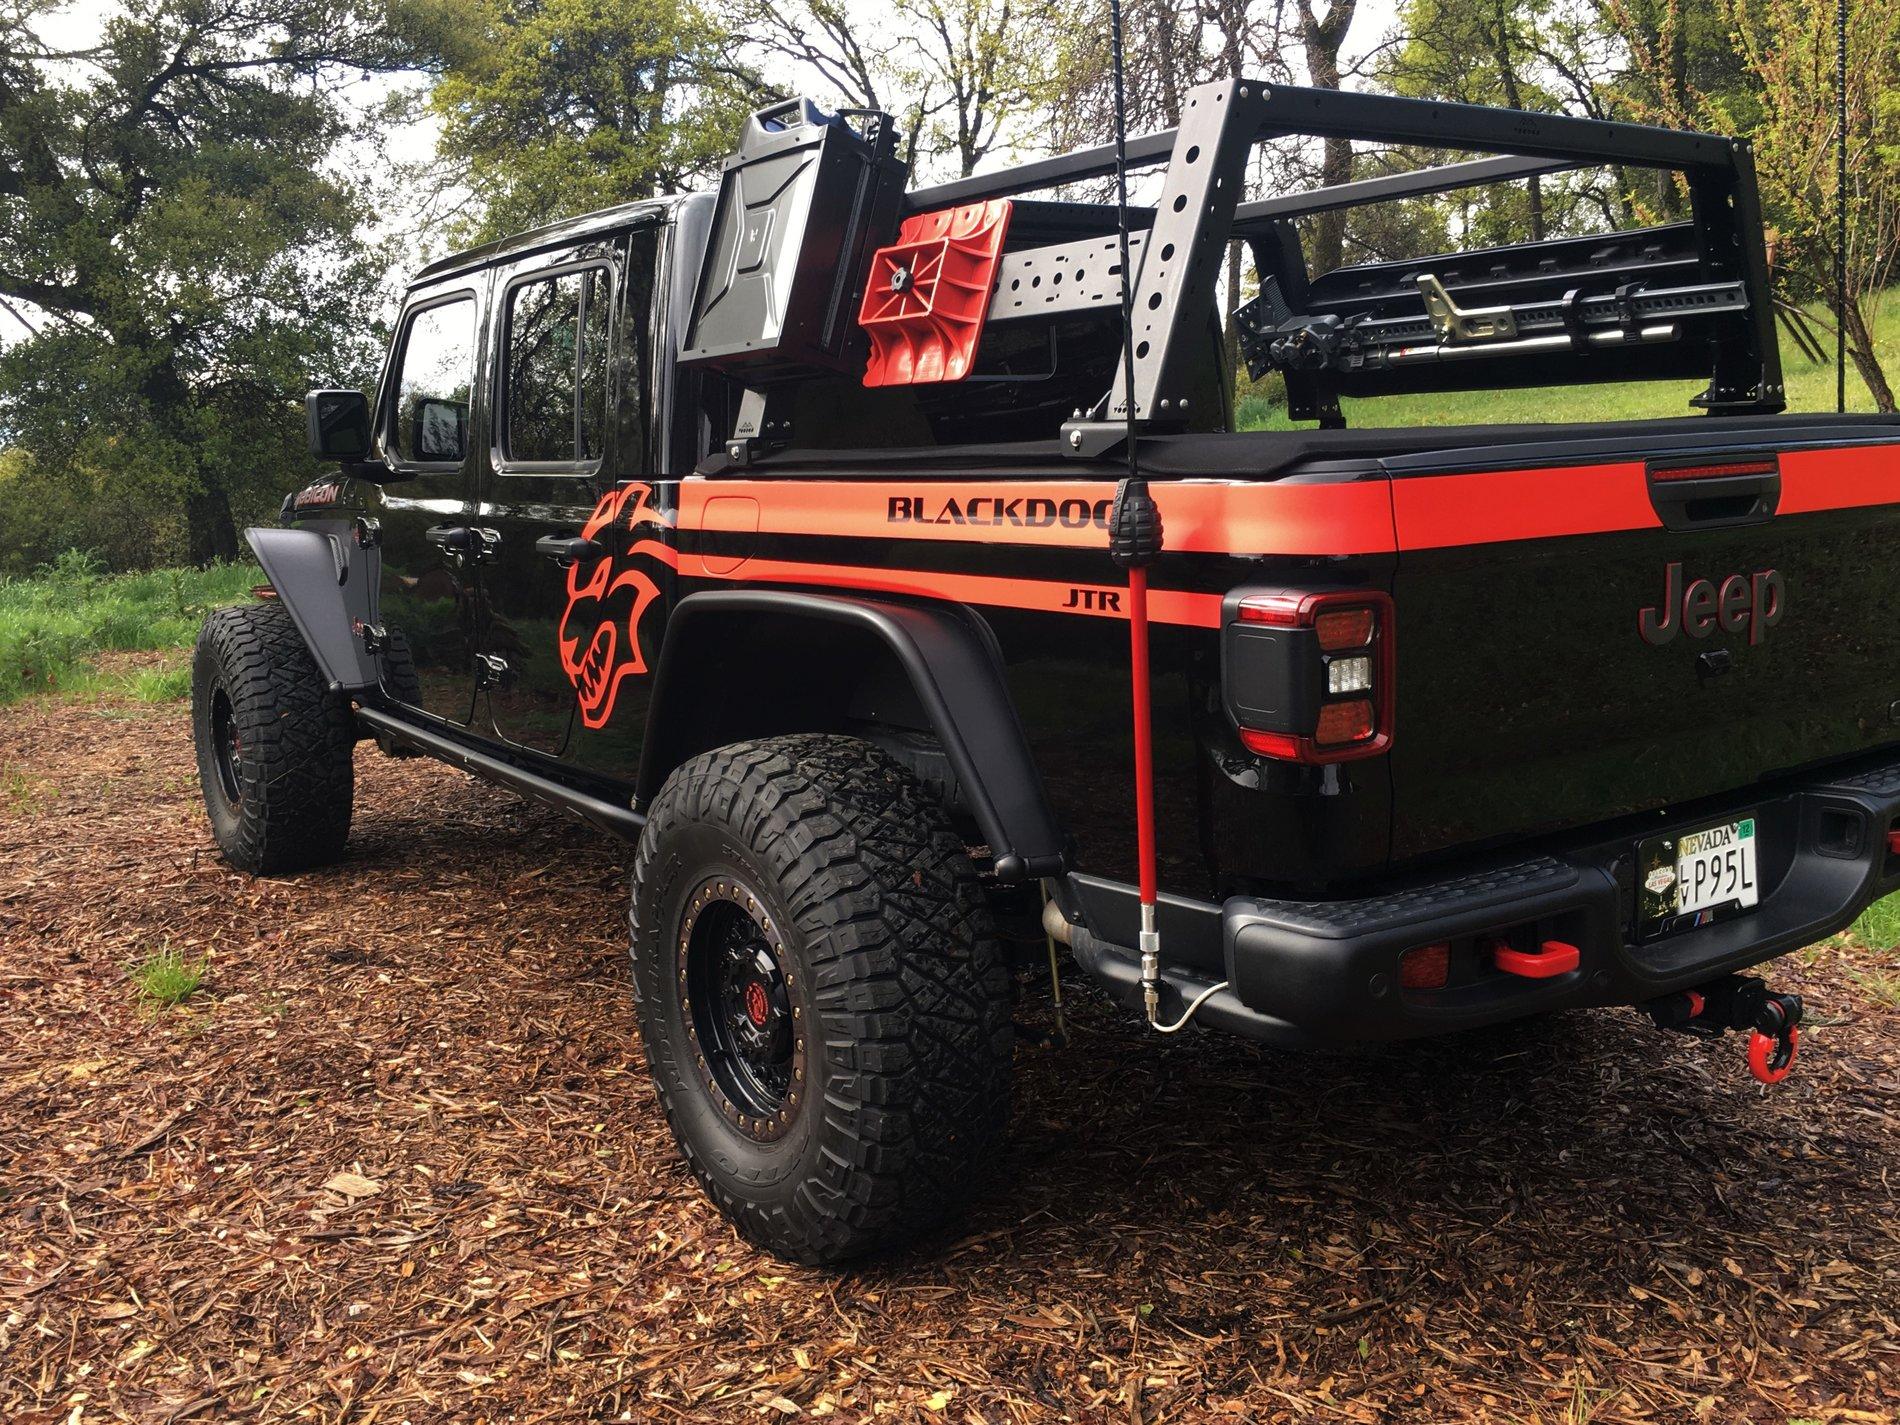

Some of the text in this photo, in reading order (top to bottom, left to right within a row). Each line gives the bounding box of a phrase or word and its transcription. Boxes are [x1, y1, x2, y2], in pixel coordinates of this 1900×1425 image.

[1062, 588, 1122, 613] JTR
[1638, 562, 1785, 646] Jeep
[1678, 827, 1731, 857] NEVADA
[1694, 847, 1753, 903] P95L
